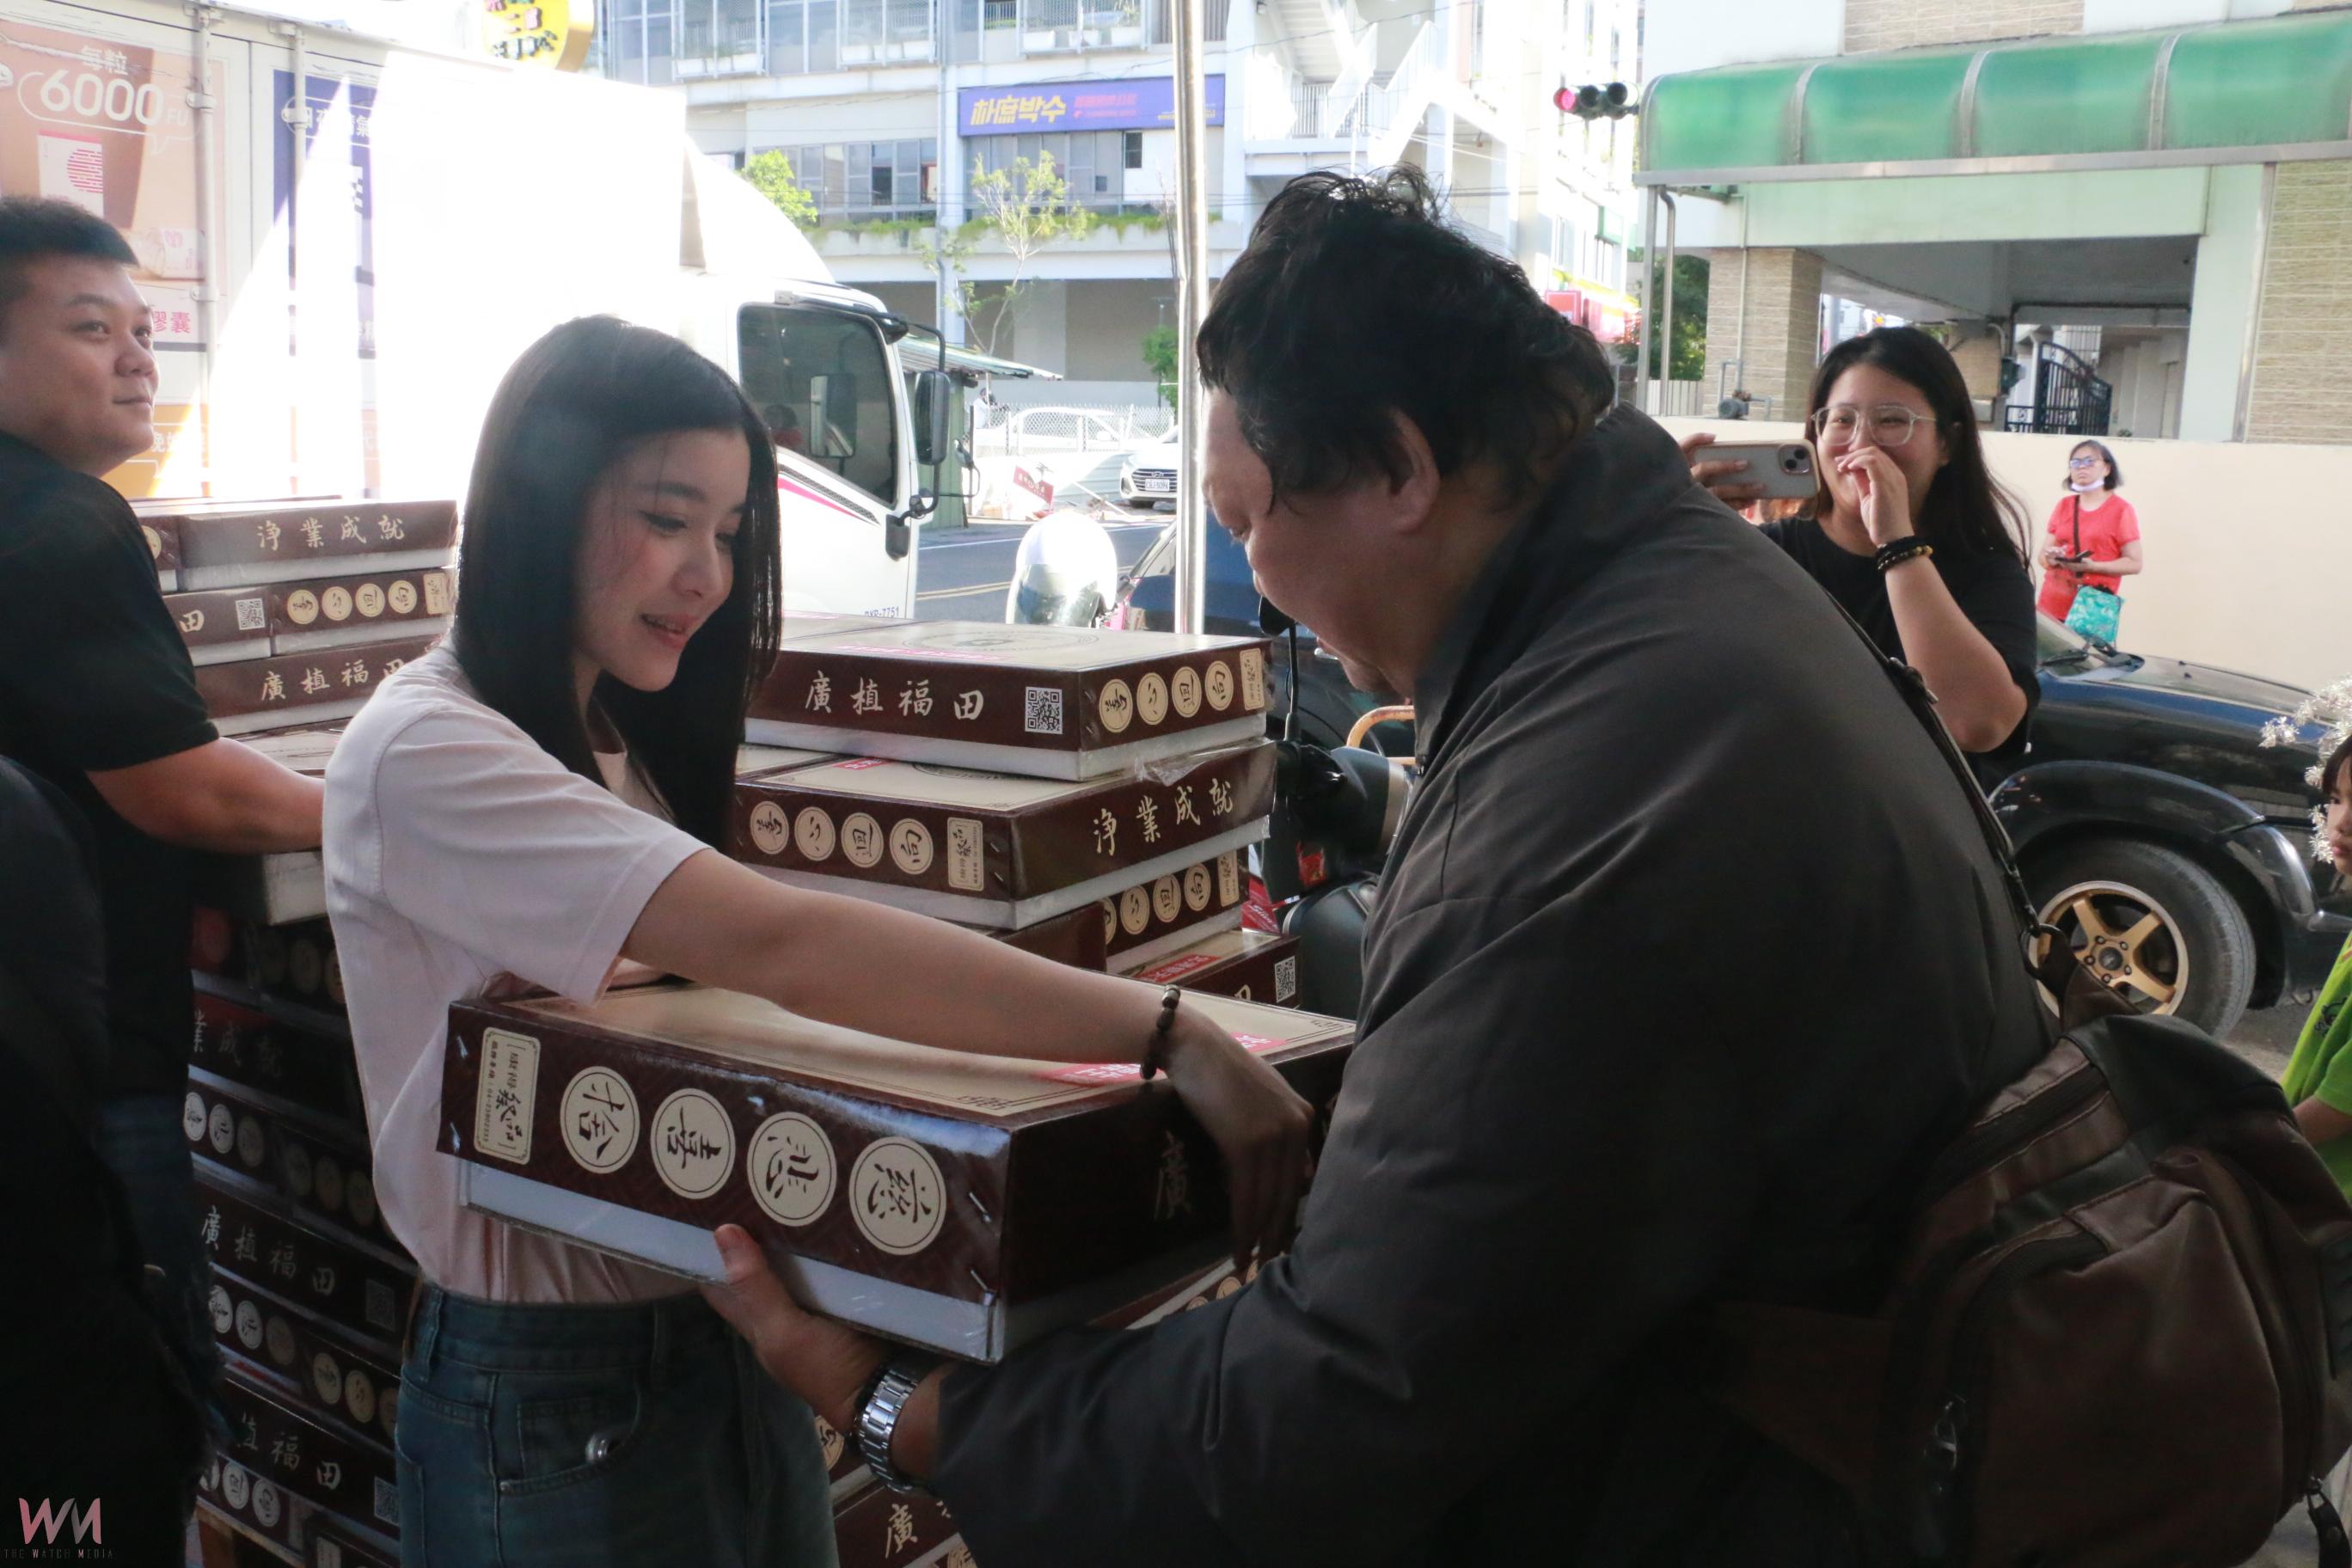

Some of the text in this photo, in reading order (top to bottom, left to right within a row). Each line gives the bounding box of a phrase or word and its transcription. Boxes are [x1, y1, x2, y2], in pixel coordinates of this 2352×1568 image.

[40, 69, 164, 126] 6000
[805, 670, 984, 721] 廣植福田
